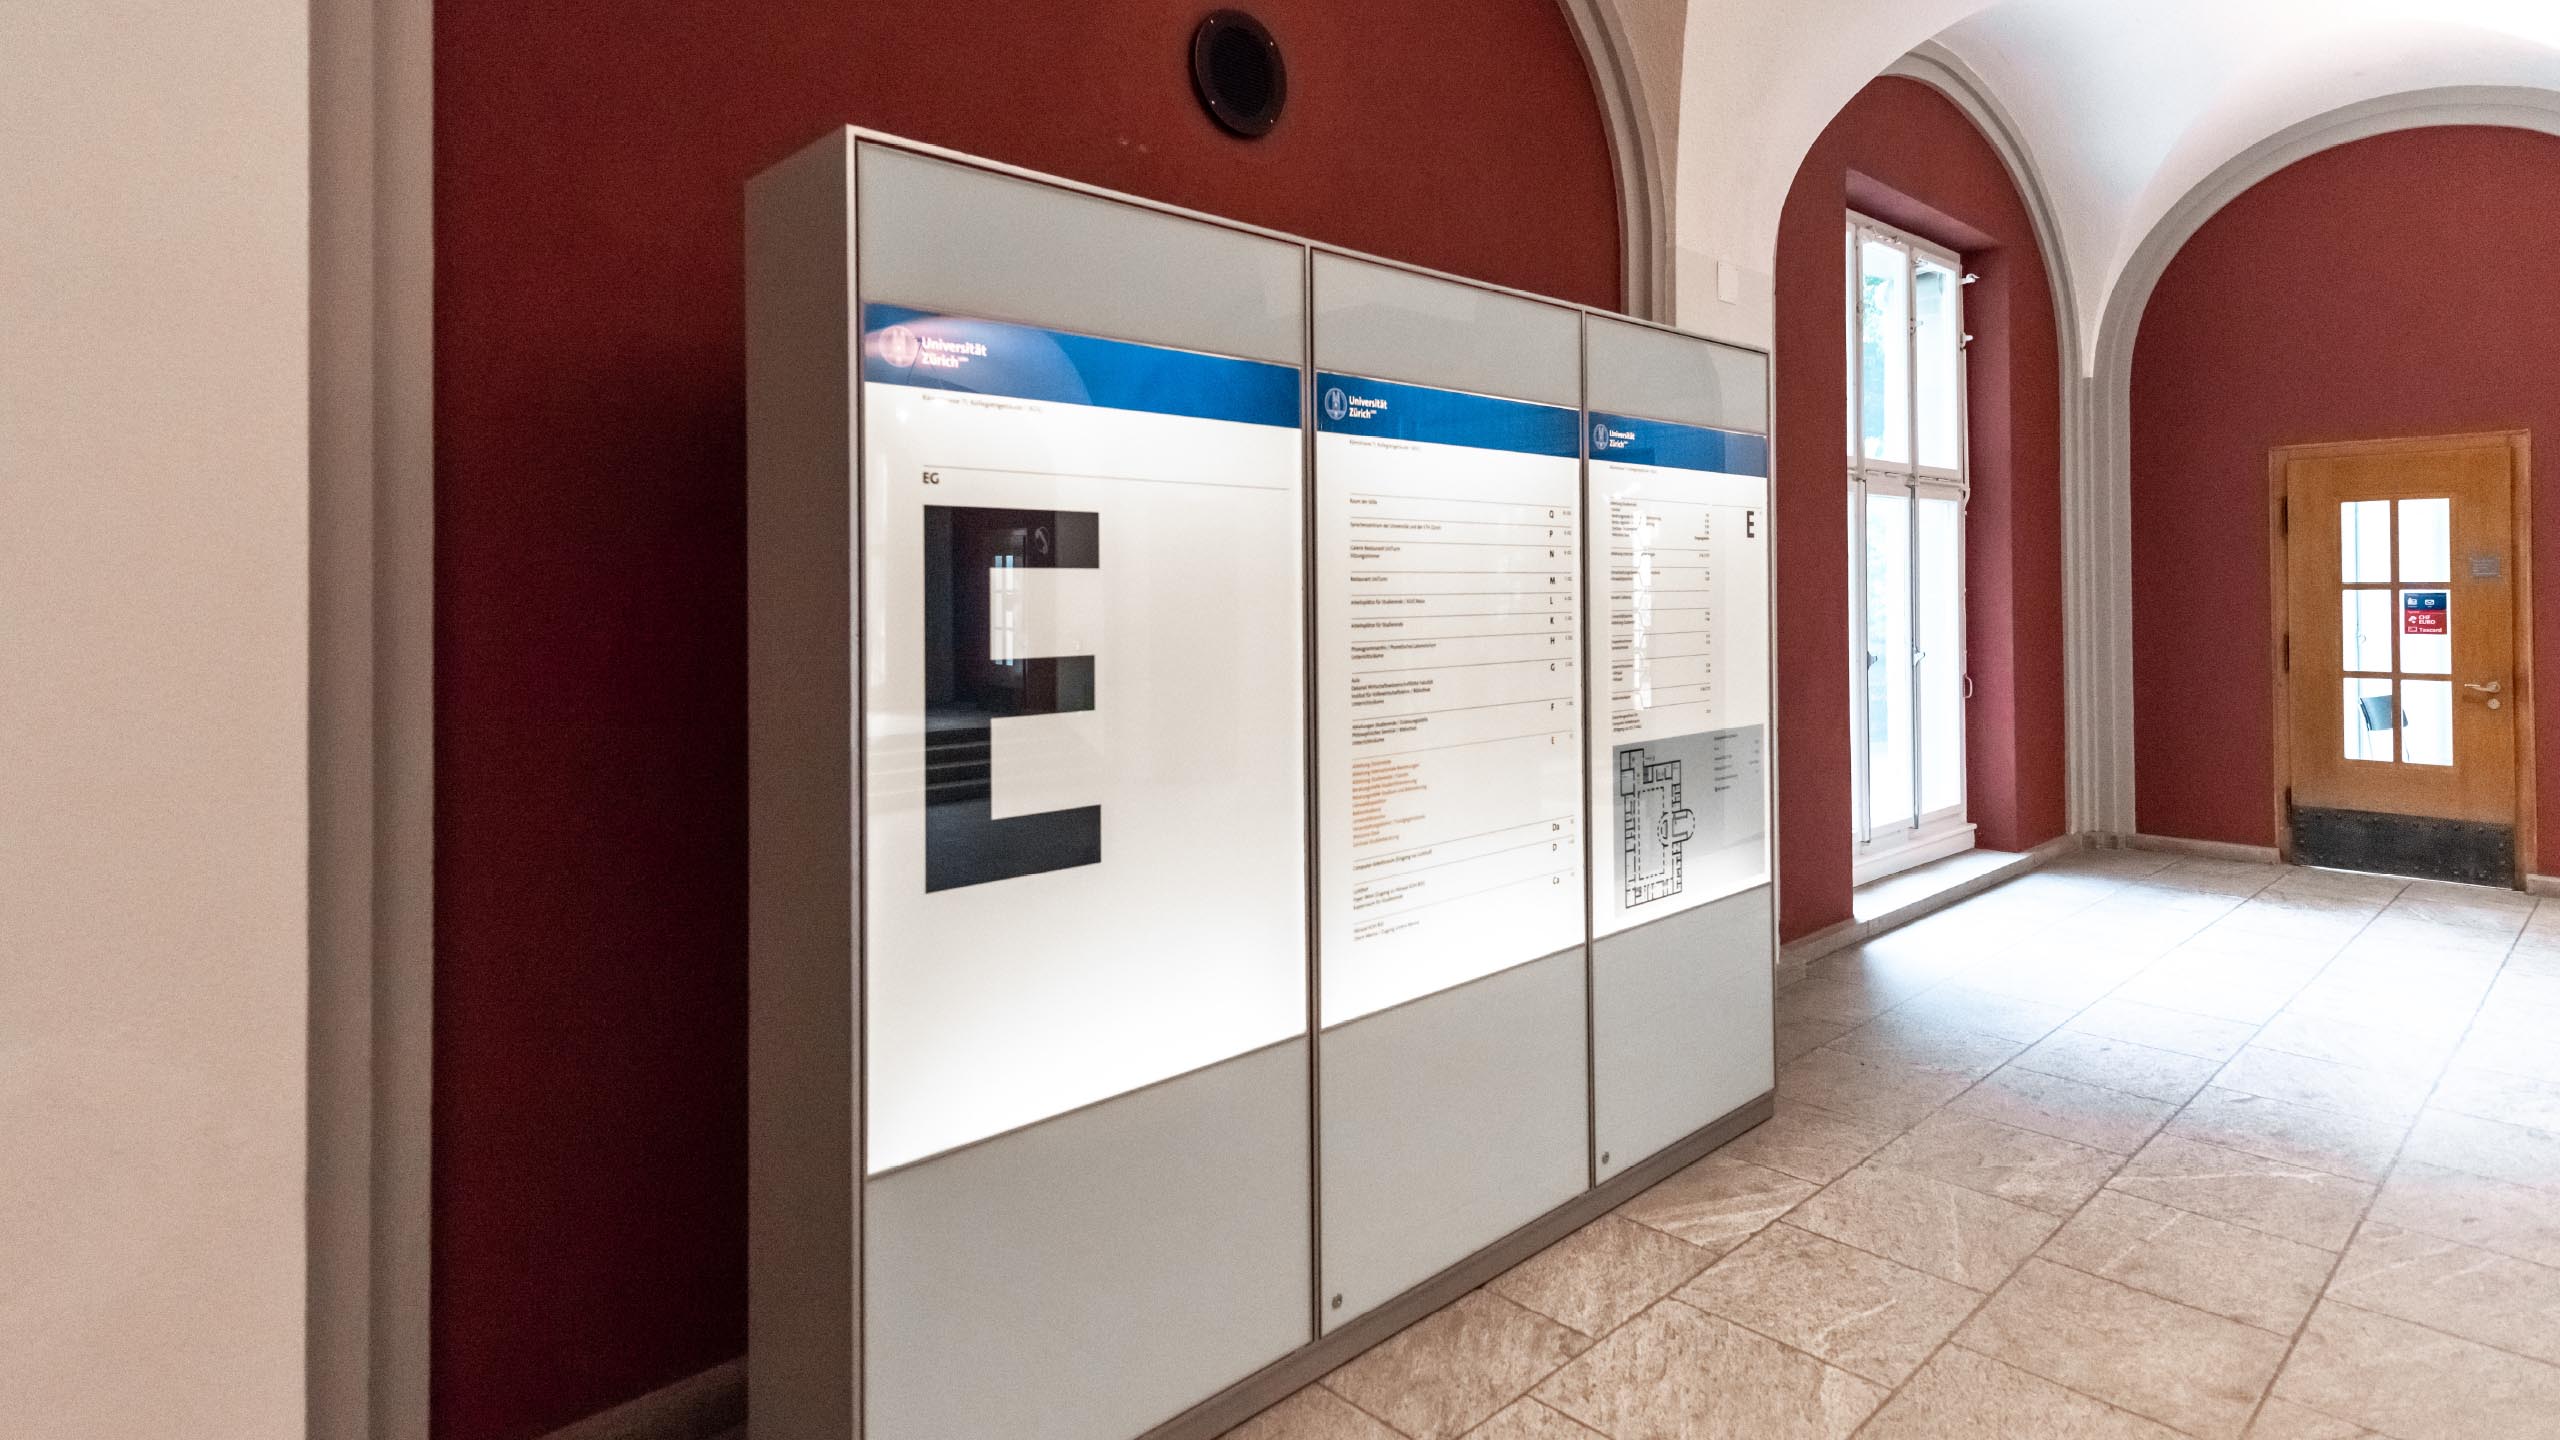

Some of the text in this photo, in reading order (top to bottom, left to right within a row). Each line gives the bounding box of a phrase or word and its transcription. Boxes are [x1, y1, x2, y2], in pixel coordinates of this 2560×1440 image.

[921, 335, 988, 357] Universität
[922, 351, 960, 368] Zürich
[1349, 394, 1388, 410] Universität
[1349, 407, 1372, 419] Zürich
[1609, 429, 1635, 440] Universität
[1609, 439, 1625, 449] Zürich
[922, 471, 940, 484] EG
[1549, 510, 1554, 519] Q
[1746, 510, 1755, 538] E
[1549, 550, 1554, 558] N
[1550, 576, 1556, 585] M
[1550, 636, 1555, 645] H
[924, 504, 1102, 895] E
